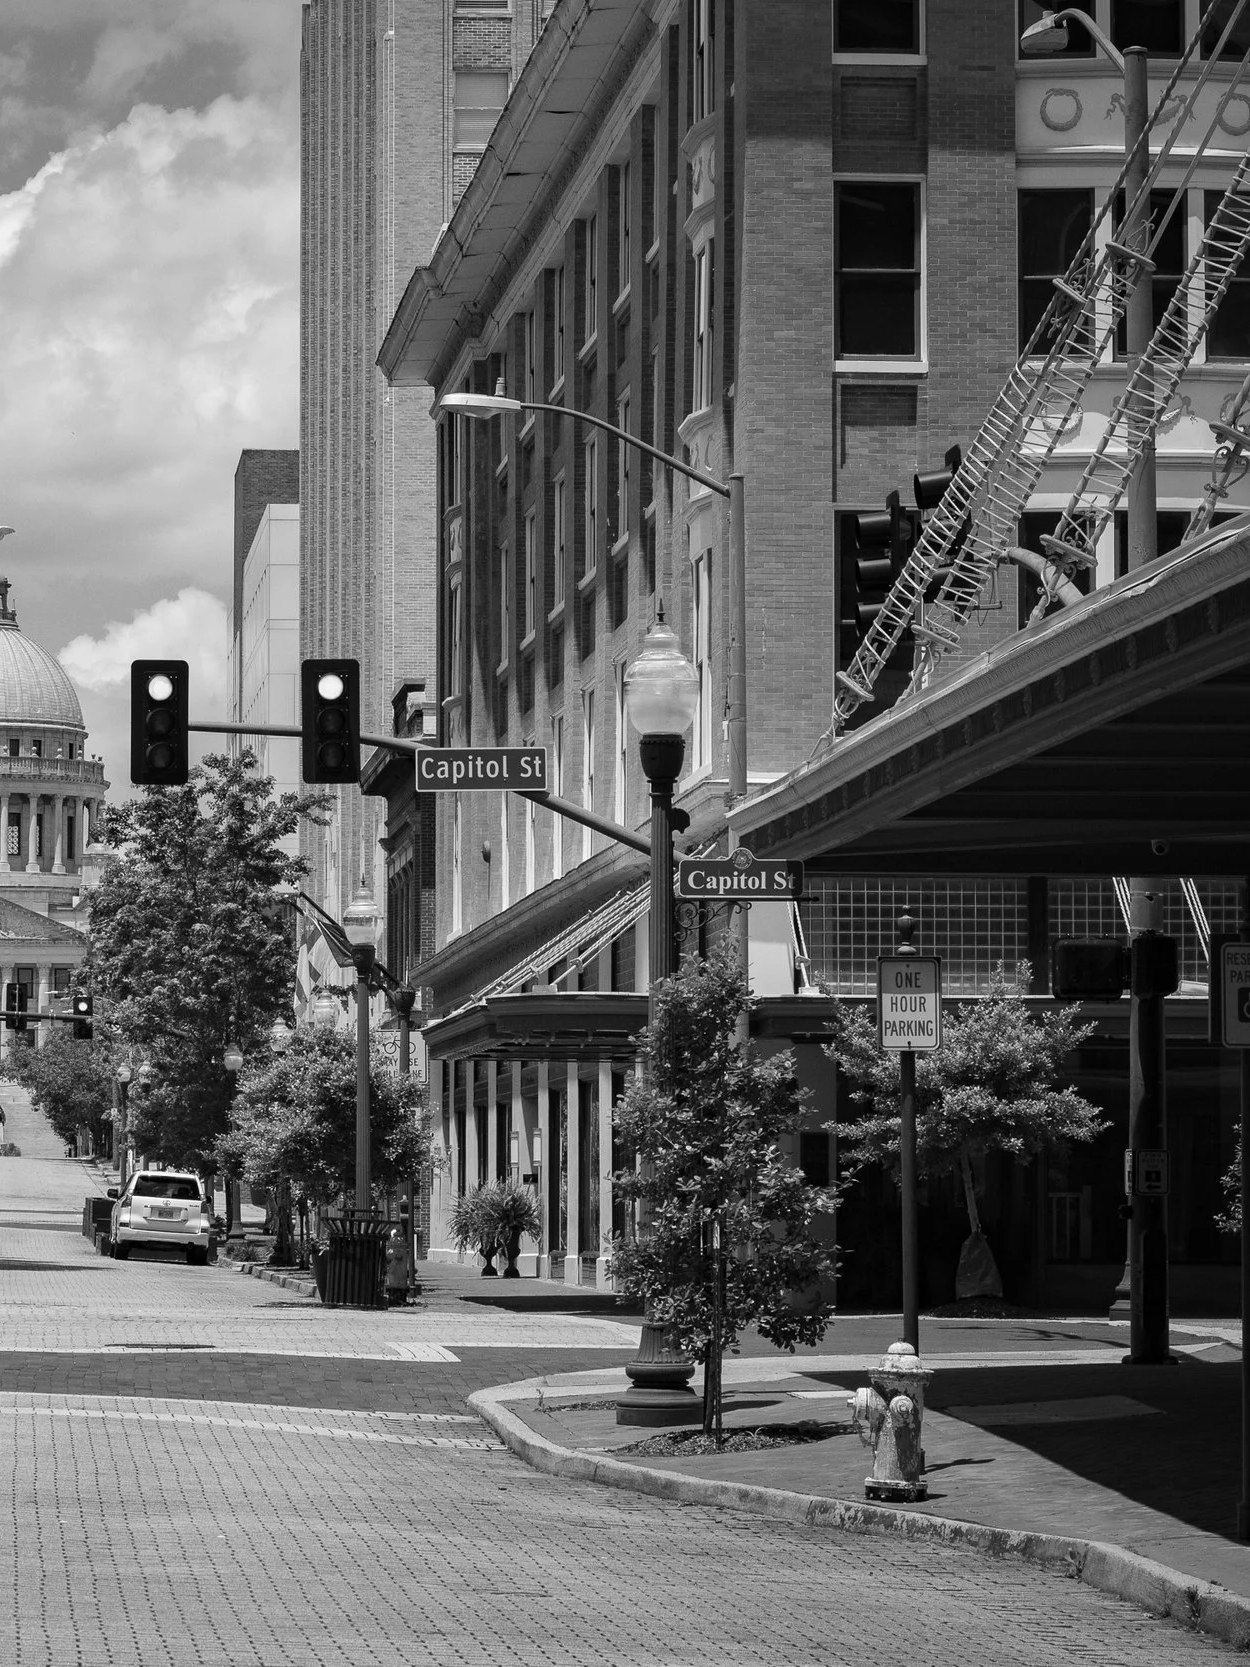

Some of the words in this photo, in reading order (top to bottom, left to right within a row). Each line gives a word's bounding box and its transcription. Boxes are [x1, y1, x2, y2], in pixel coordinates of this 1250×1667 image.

[421, 755, 509, 784] Capitol
[520, 756, 542, 778] St
[688, 871, 767, 895] Capitol
[773, 871, 796, 890] St
[895, 971, 922, 989] ONE
[890, 995, 927, 1013] HOUR
[884, 1020, 934, 1037] PARKING
